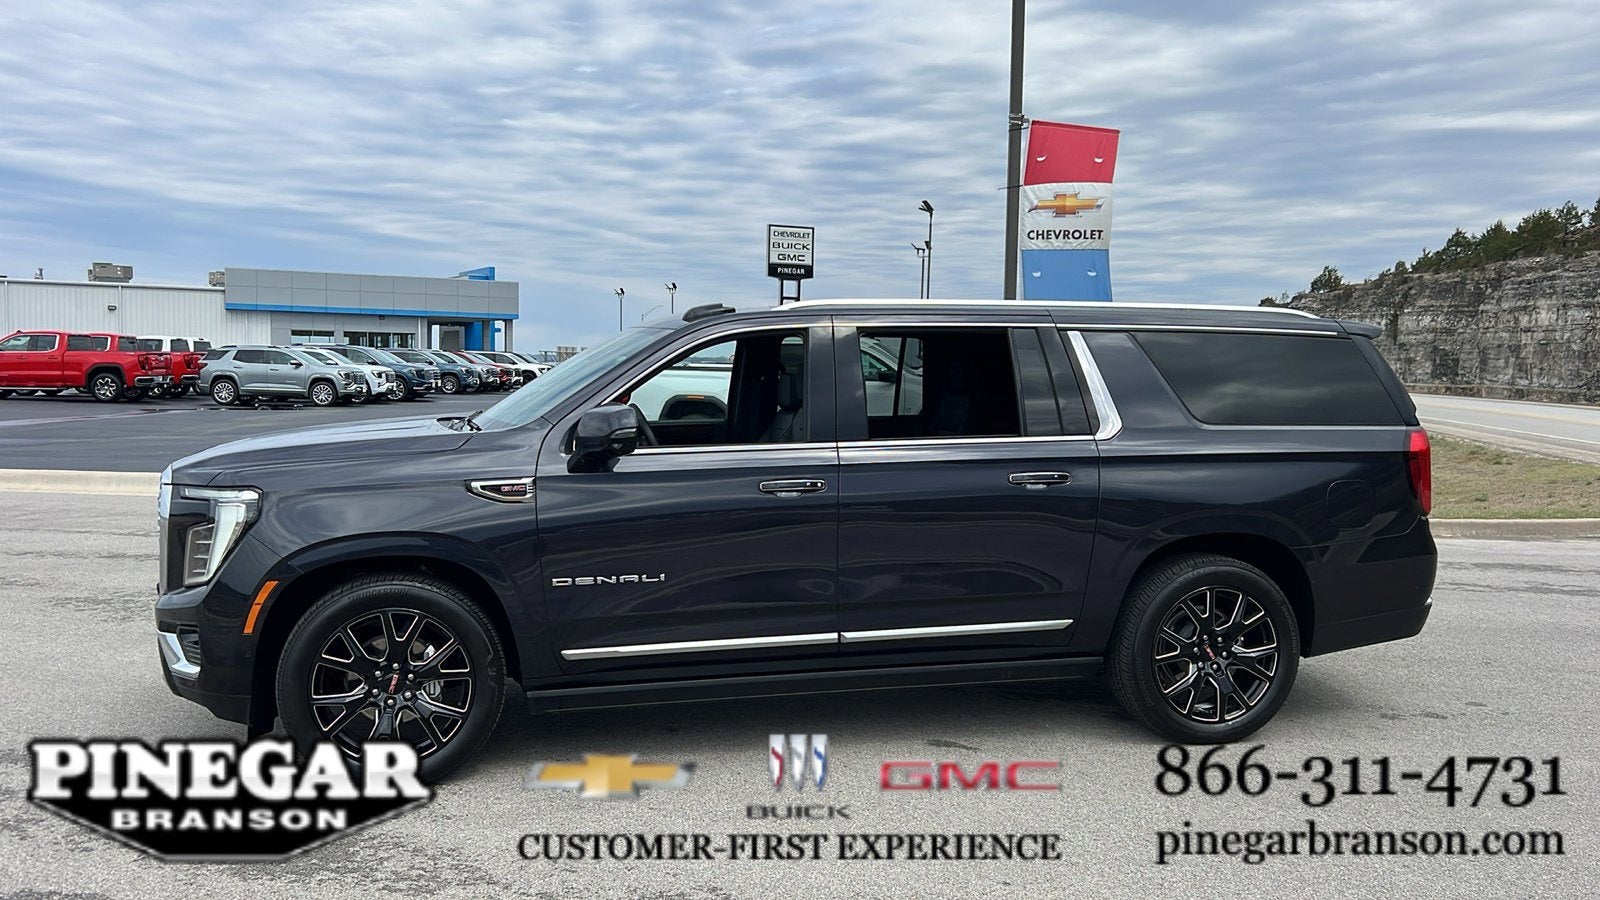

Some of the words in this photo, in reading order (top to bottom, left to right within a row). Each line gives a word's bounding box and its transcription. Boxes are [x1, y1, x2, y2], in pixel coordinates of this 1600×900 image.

[773, 230, 811, 239] CHEVROLET
[1027, 229, 1104, 240] CHEVROLET
[772, 241, 810, 251] BUICK
[777, 253, 805, 262] GMC
[777, 267, 805, 275] PINEGAR
[552, 573, 666, 587] DENALI
